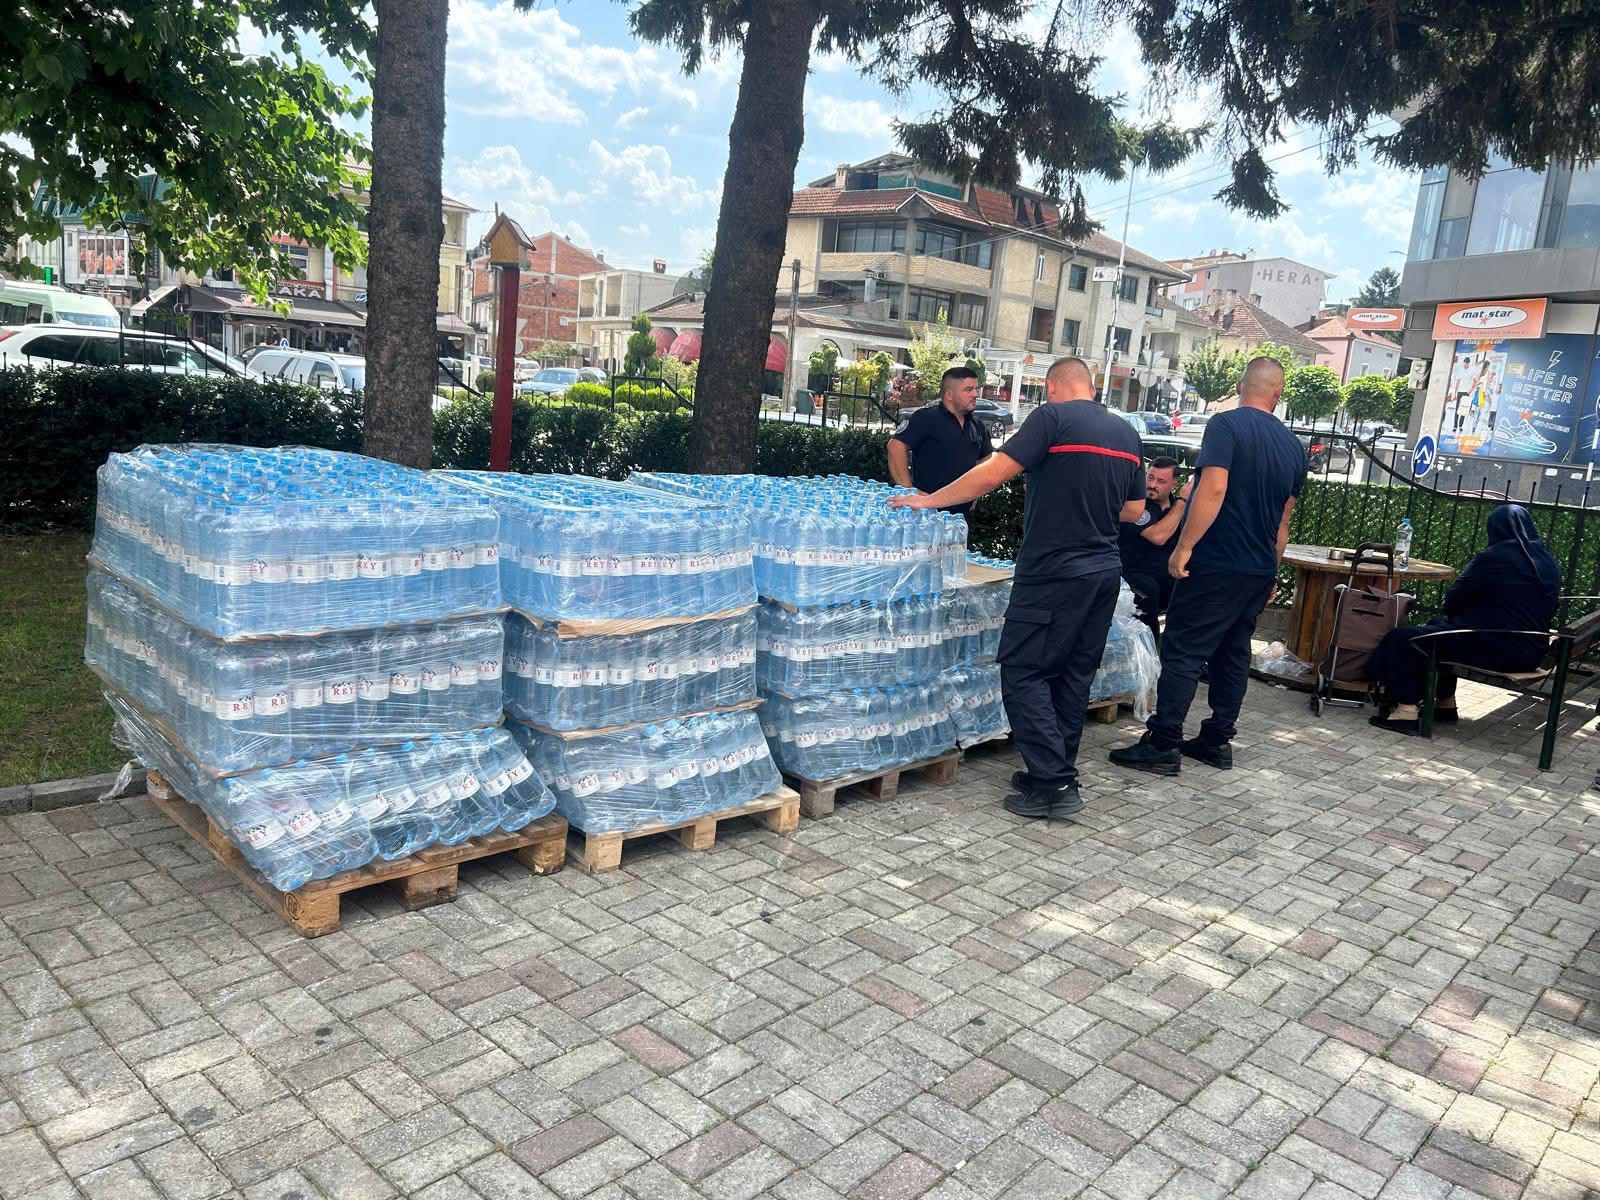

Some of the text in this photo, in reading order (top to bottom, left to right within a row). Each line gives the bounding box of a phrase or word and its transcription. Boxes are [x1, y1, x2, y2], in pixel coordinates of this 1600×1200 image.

[1262, 269, 1311, 285] HERA
[1461, 310, 1513, 319] mat star
[1560, 374, 1578, 389] IS
[1511, 381, 1573, 404] BETTER
